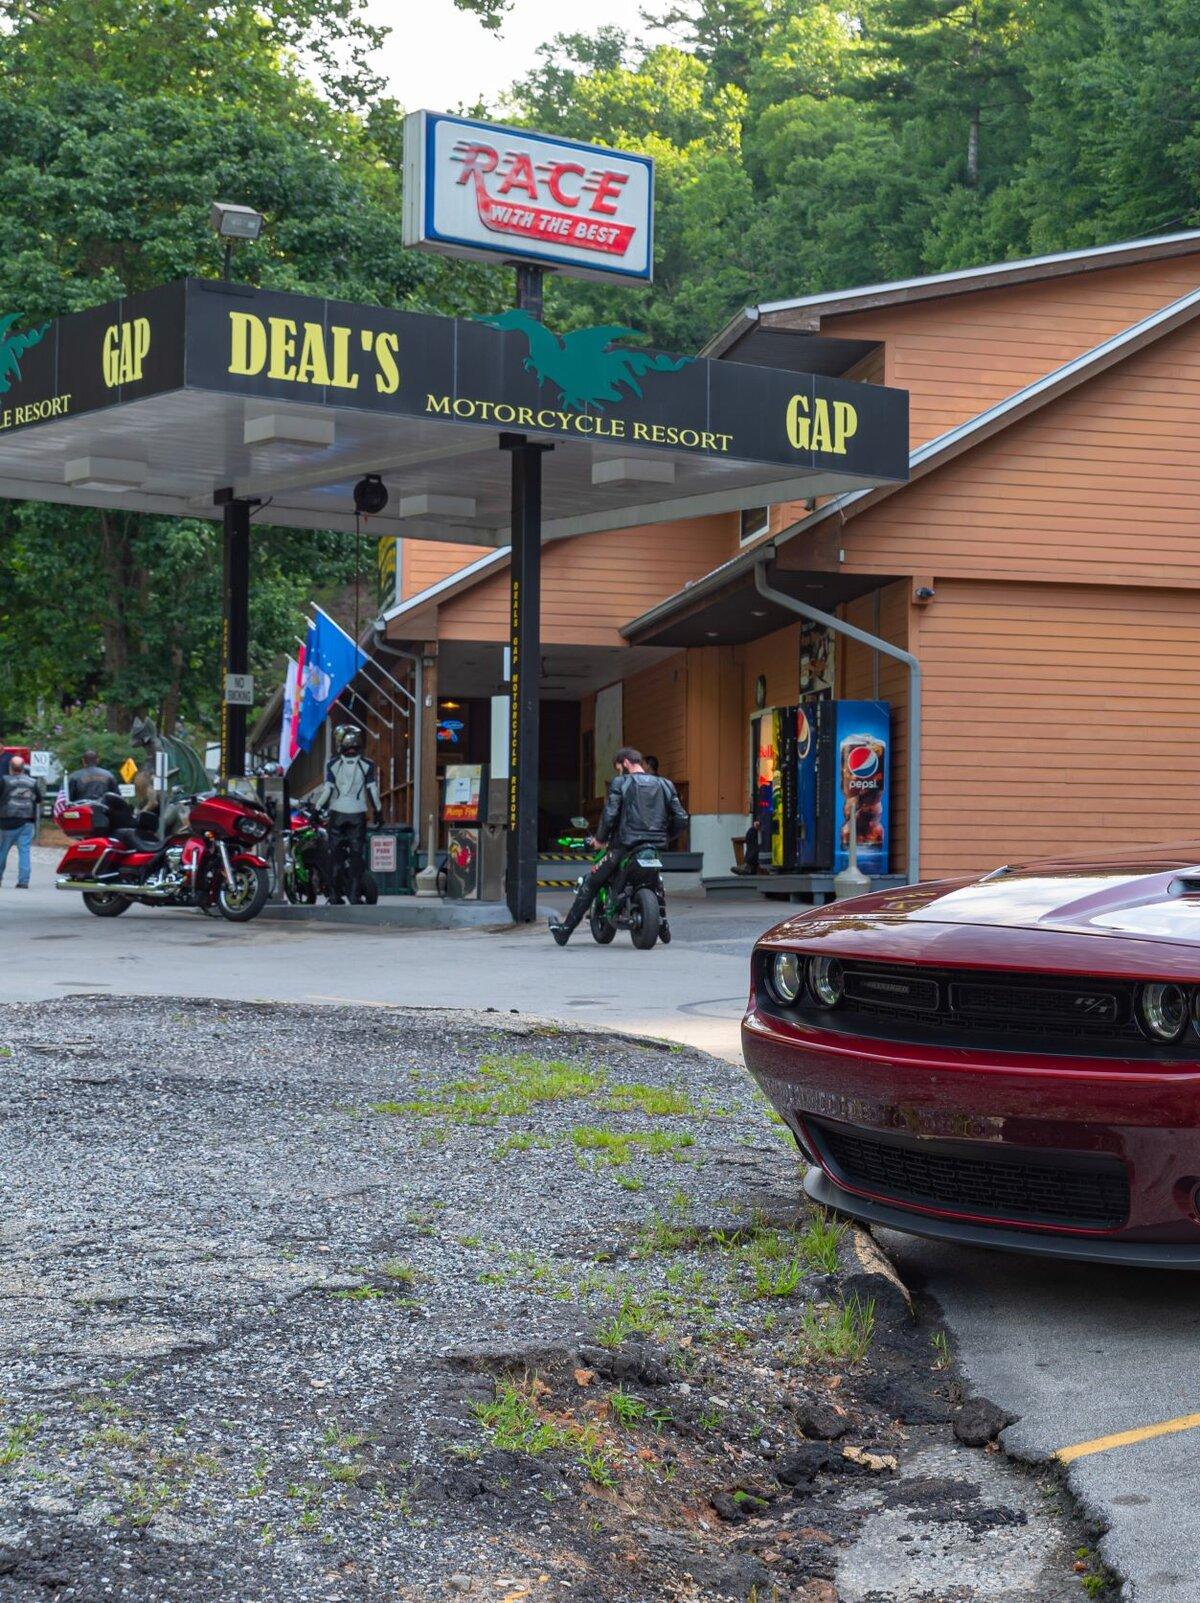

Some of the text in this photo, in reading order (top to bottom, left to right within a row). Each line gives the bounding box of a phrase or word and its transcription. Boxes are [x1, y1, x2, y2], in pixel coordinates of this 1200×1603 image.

[451, 141, 629, 216] RACE
[490, 205, 621, 246] WITH THE BEST
[102, 317, 151, 389] GAP
[228, 311, 400, 395] DEAL'S
[15, 394, 72, 425] RESORT
[425, 393, 734, 452] MOTORCYCLE RESORT
[785, 393, 858, 455] GAP
[849, 780, 877, 790] pepsi
